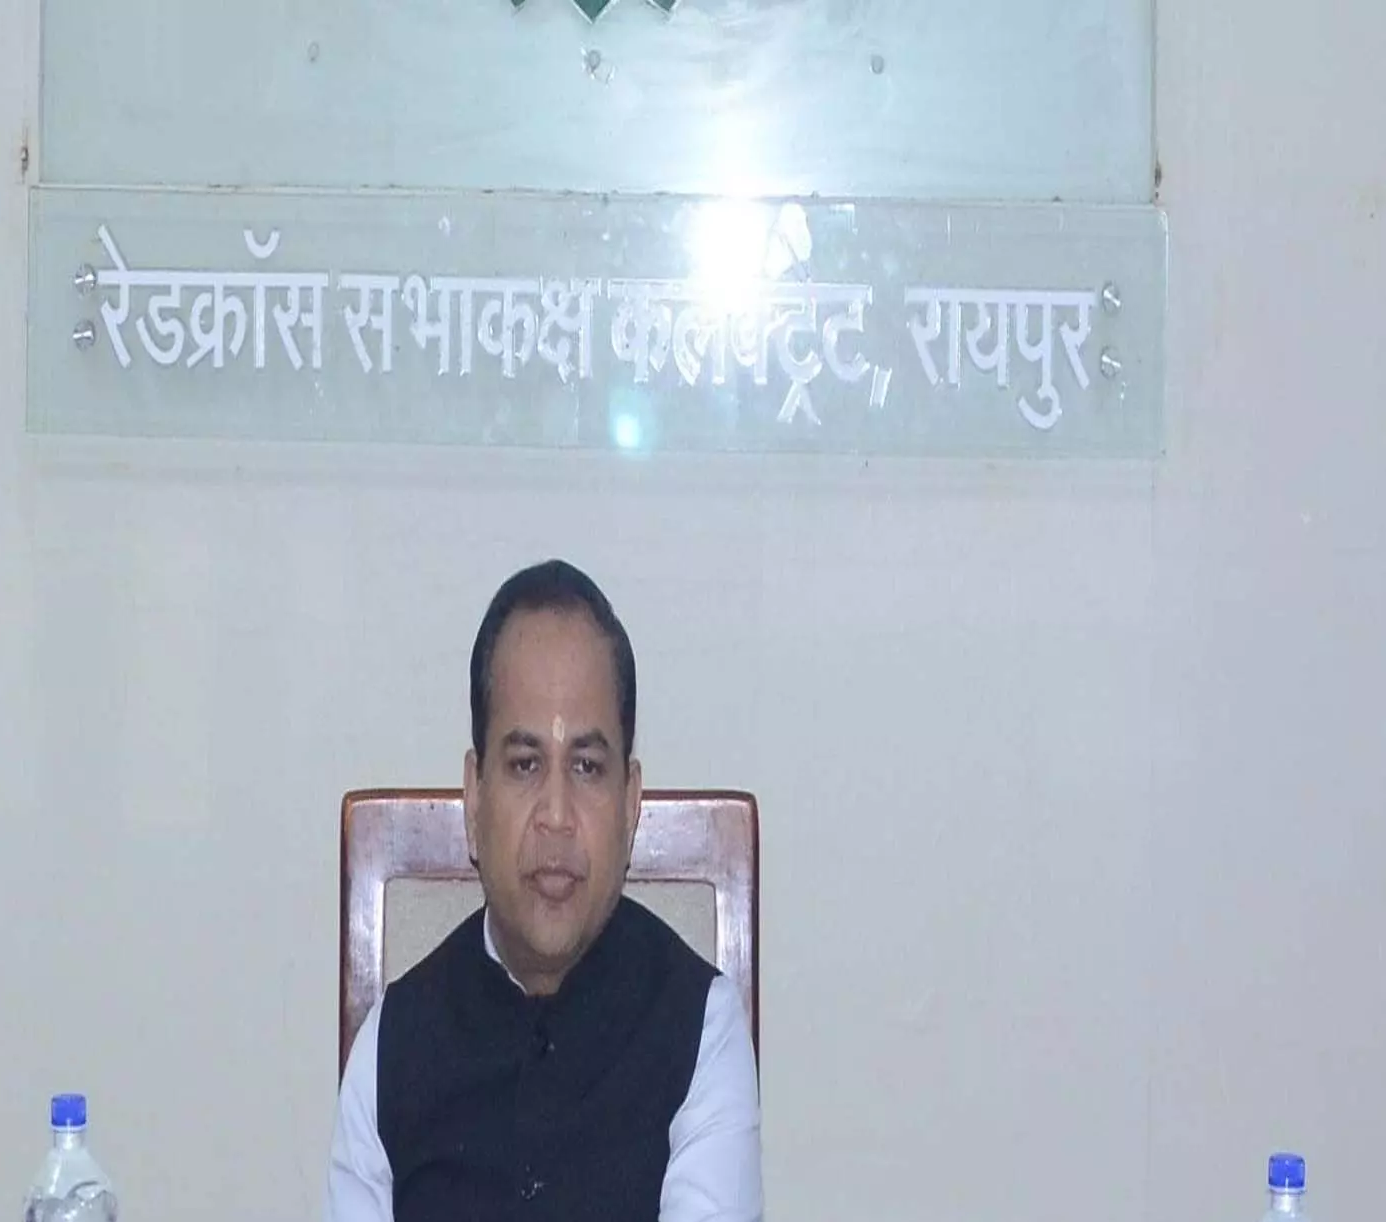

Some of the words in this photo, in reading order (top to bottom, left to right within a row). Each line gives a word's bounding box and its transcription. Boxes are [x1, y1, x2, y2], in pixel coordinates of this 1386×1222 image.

[97, 224, 329, 369] रेडक्रॉस
[338, 274, 602, 383] सभाकक्ष
[607, 232, 892, 426] कलक्ट्रेट,
[904, 286, 1096, 430] रायपुर
